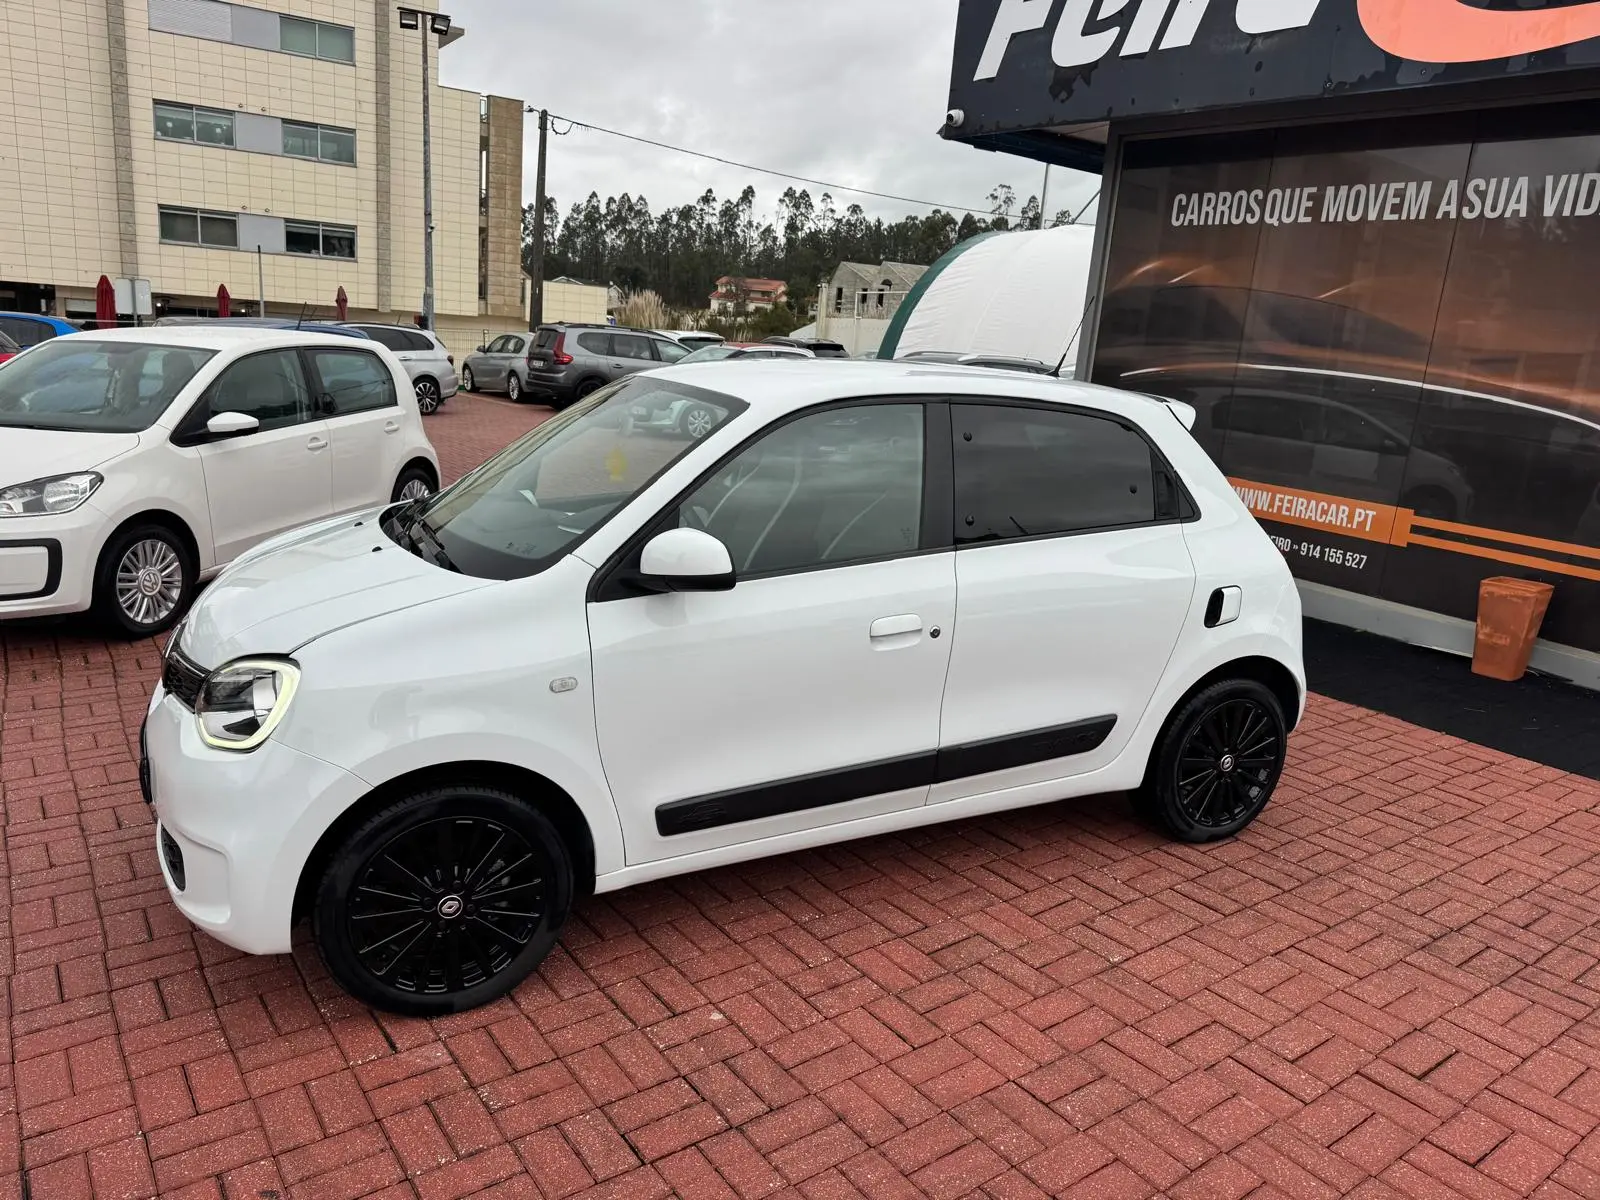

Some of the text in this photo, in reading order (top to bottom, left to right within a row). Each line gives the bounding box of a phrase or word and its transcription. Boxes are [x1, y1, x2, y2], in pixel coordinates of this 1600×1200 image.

[1320, 181, 1432, 223] MOVEM
[1543, 172, 1600, 217] VID
[1270, 535, 1291, 552] IRO
[1300, 542, 1320, 559] 914
[1324, 547, 1344, 565] 155
[1345, 552, 1367, 570] 527
